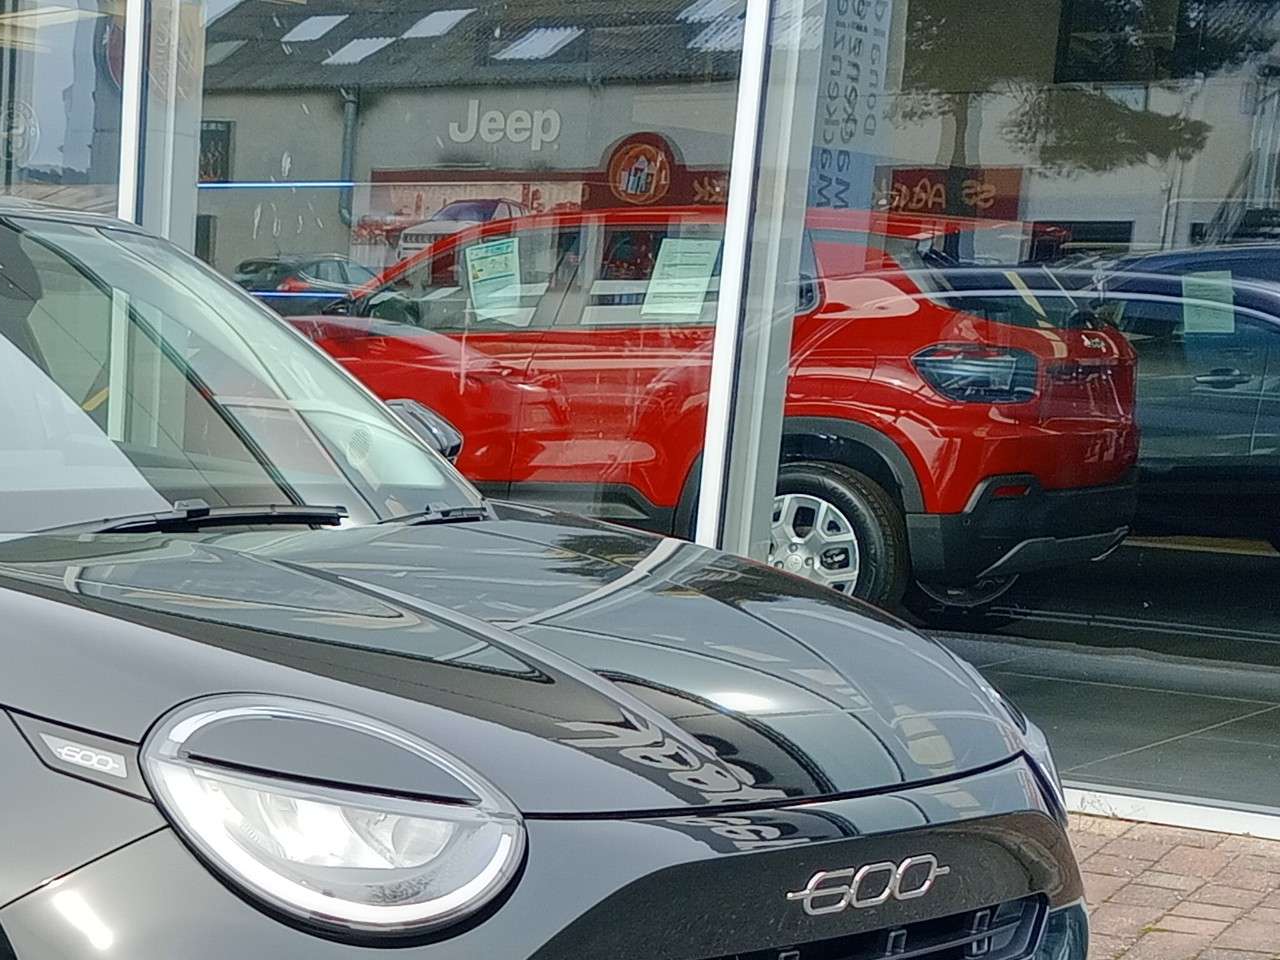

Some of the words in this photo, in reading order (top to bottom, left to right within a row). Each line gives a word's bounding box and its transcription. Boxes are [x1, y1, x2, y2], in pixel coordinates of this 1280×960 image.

[448, 99, 561, 151] Jeep
[55, 745, 121, 771] 600
[787, 853, 950, 917] 600
